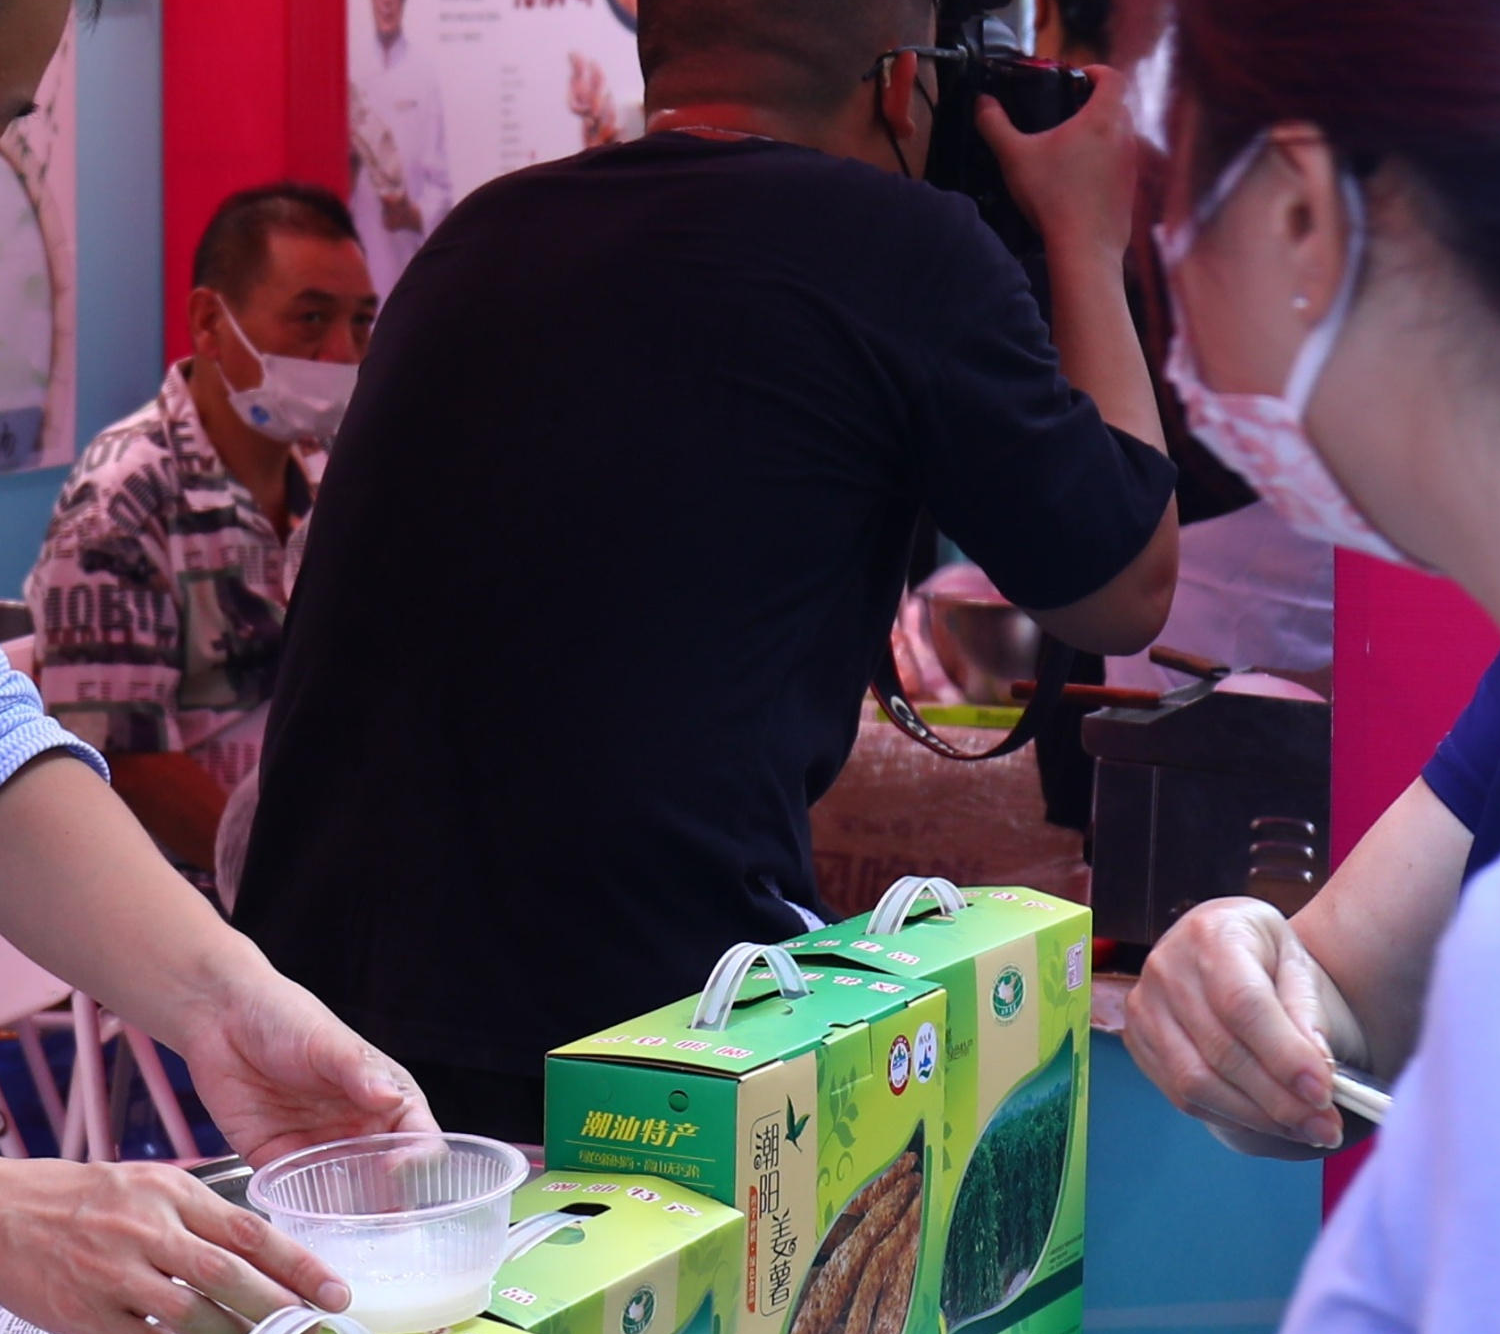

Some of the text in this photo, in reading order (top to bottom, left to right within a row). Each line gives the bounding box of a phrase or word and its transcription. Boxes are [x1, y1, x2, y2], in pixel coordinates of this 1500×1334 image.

[580, 1109, 700, 1148] 潮汕特产
[753, 1122, 798, 1307] 潮阳姜薯
